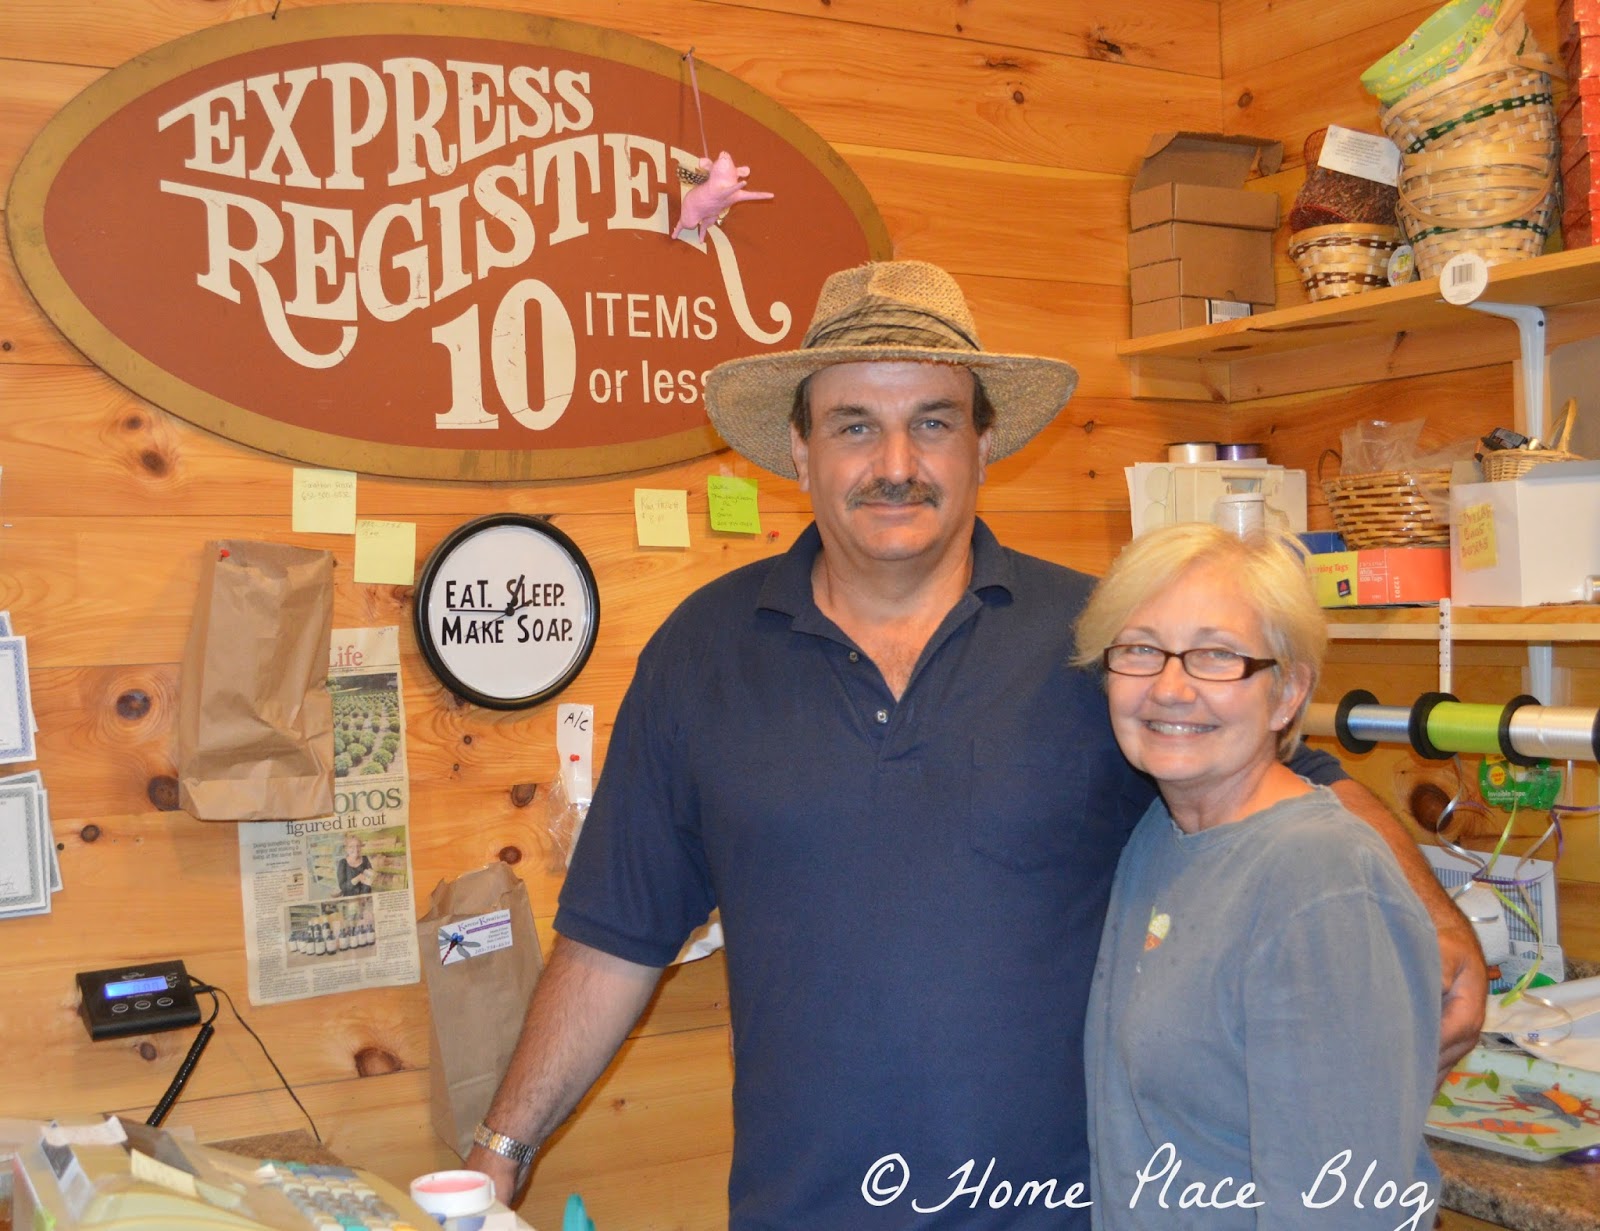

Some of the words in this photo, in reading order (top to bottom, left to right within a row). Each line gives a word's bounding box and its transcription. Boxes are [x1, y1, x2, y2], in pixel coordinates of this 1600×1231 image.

[157, 57, 594, 190] EXPRESS
[431, 278, 577, 431] 10
[585, 291, 718, 340] ITEMS
[589, 368, 629, 404] or
[445, 579, 493, 609] EAT.
[506, 579, 566, 608] SLEEP.
[441, 615, 505, 646] MAKE
[516, 614, 574, 644] SOAP.
[329, 644, 364, 668] ife
[563, 710, 589, 732] A/C
[285, 816, 342, 838] figured
[347, 815, 358, 829] it
[362, 812, 387, 827] out
